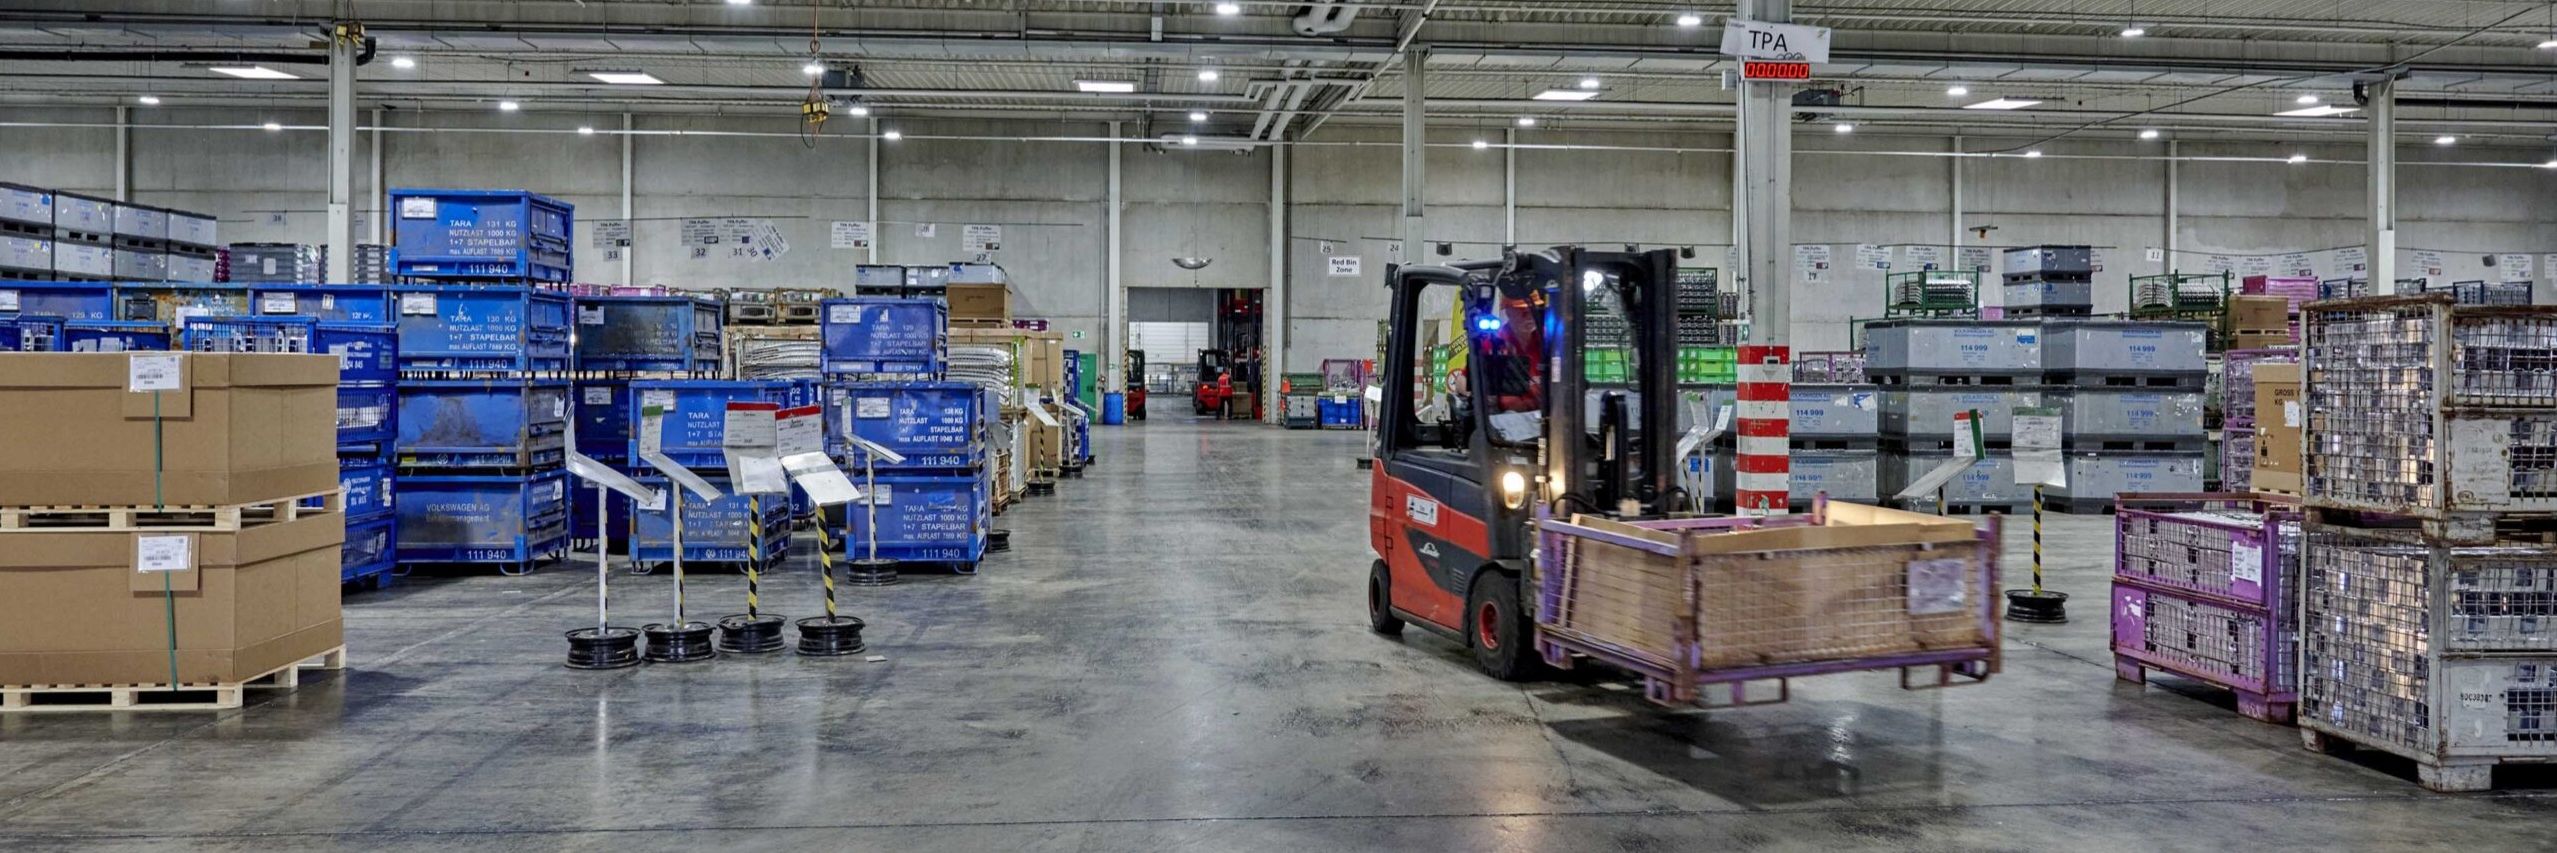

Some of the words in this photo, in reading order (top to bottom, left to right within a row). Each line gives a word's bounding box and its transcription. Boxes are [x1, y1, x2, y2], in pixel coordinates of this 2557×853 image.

[1748, 30, 1788, 52] TPA
[486, 220, 500, 228] 131
[505, 220, 517, 228] KG
[695, 248, 706, 256] 32
[732, 248, 742, 256] 31
[1390, 244, 1400, 252] 24
[608, 250, 618, 260] 33
[976, 254, 986, 262] 27
[1332, 258, 1345, 266] Red
[1346, 258, 1357, 266] Bin
[469, 264, 485, 274] 111
[488, 264, 508, 274] 940
[504, 315, 516, 323] KG
[504, 324, 516, 332] KG
[470, 334, 516, 342] STAPELBAR
[469, 360, 484, 369] 111
[488, 359, 508, 369] 940
[2274, 388, 2294, 397] GROSS
[921, 456, 937, 466] 111
[940, 456, 960, 465] 940
[426, 504, 476, 512] VOLKSWAGEN
[479, 504, 490, 512] AG
[467, 550, 484, 560] 111
[488, 550, 506, 560] 940
[719, 550, 732, 558] 111
[922, 549, 939, 558] 111
[942, 549, 960, 558] 940
